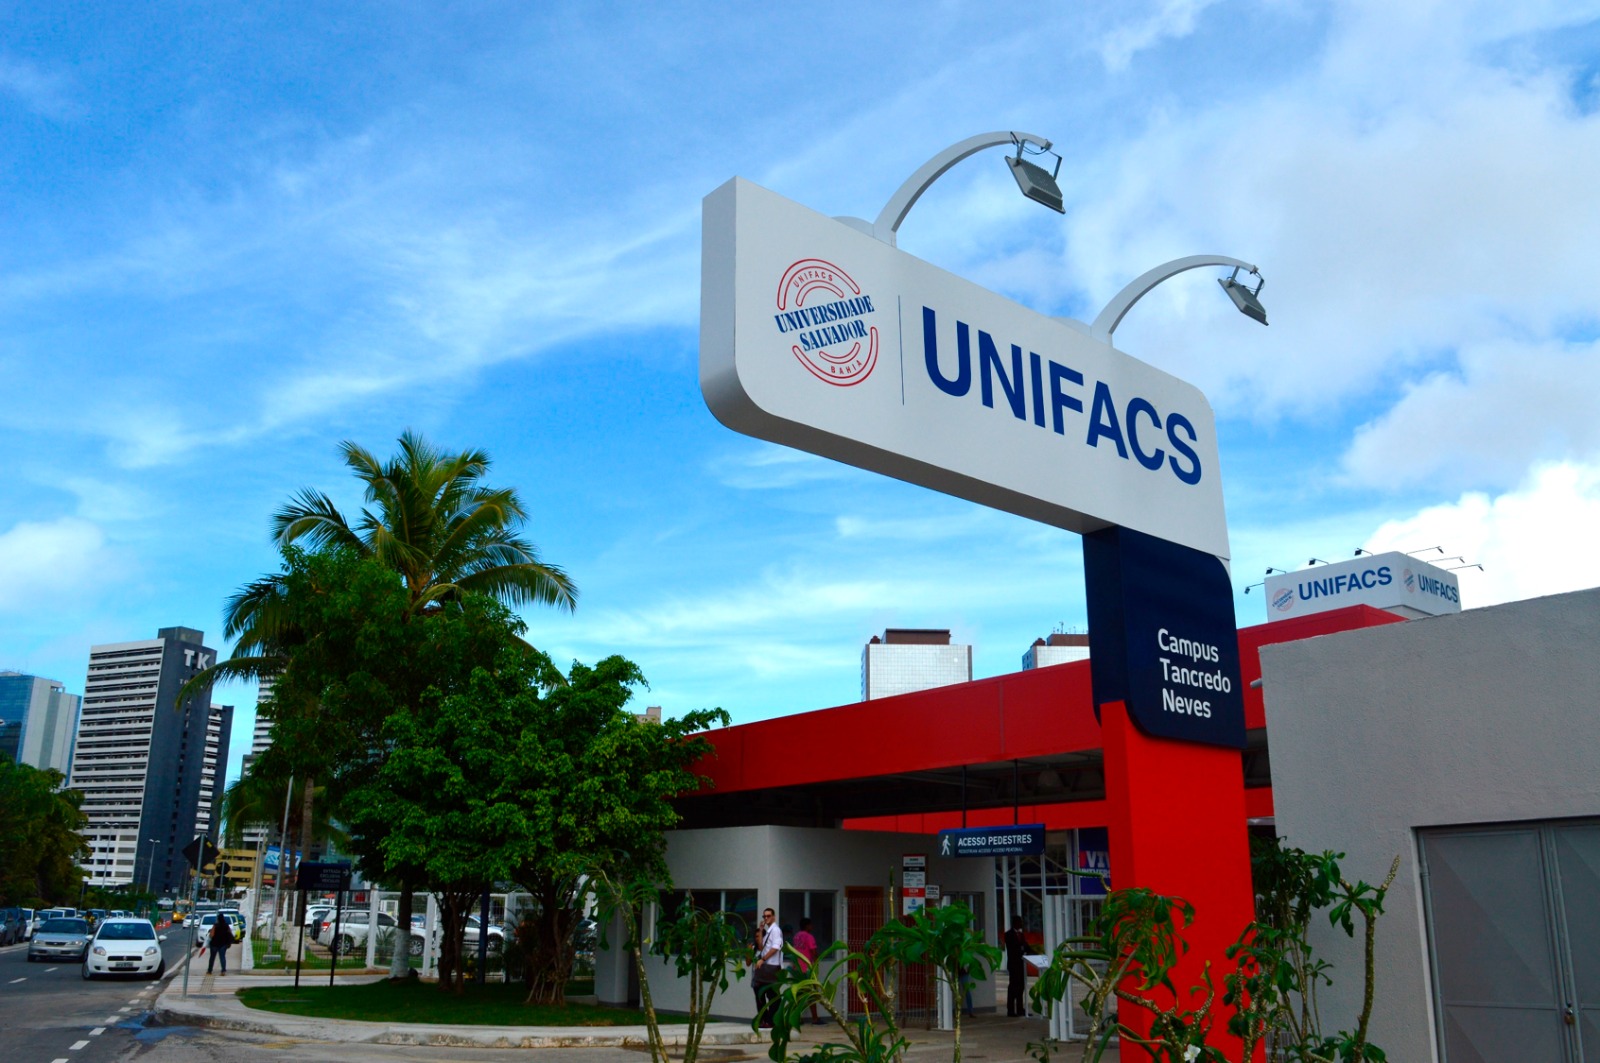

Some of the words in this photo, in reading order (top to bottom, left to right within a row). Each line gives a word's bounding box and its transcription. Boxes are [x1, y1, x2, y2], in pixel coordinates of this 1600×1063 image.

[793, 270, 833, 288] UNIFACS
[774, 295, 875, 333] UNIVERSIDADE
[799, 319, 869, 352] SALVADOR
[830, 359, 863, 375] BAHIA
[922, 305, 1202, 485] UNIFACS
[1298, 566, 1393, 601] UNIFACS
[1417, 573, 1459, 604] UNIFACS
[1157, 627, 1219, 663] Campus
[1159, 656, 1231, 694] Tancredo
[1162, 687, 1212, 719] Neves
[958, 836, 986, 847] ACESSO
[988, 834, 1032, 846] PEDESTRES
